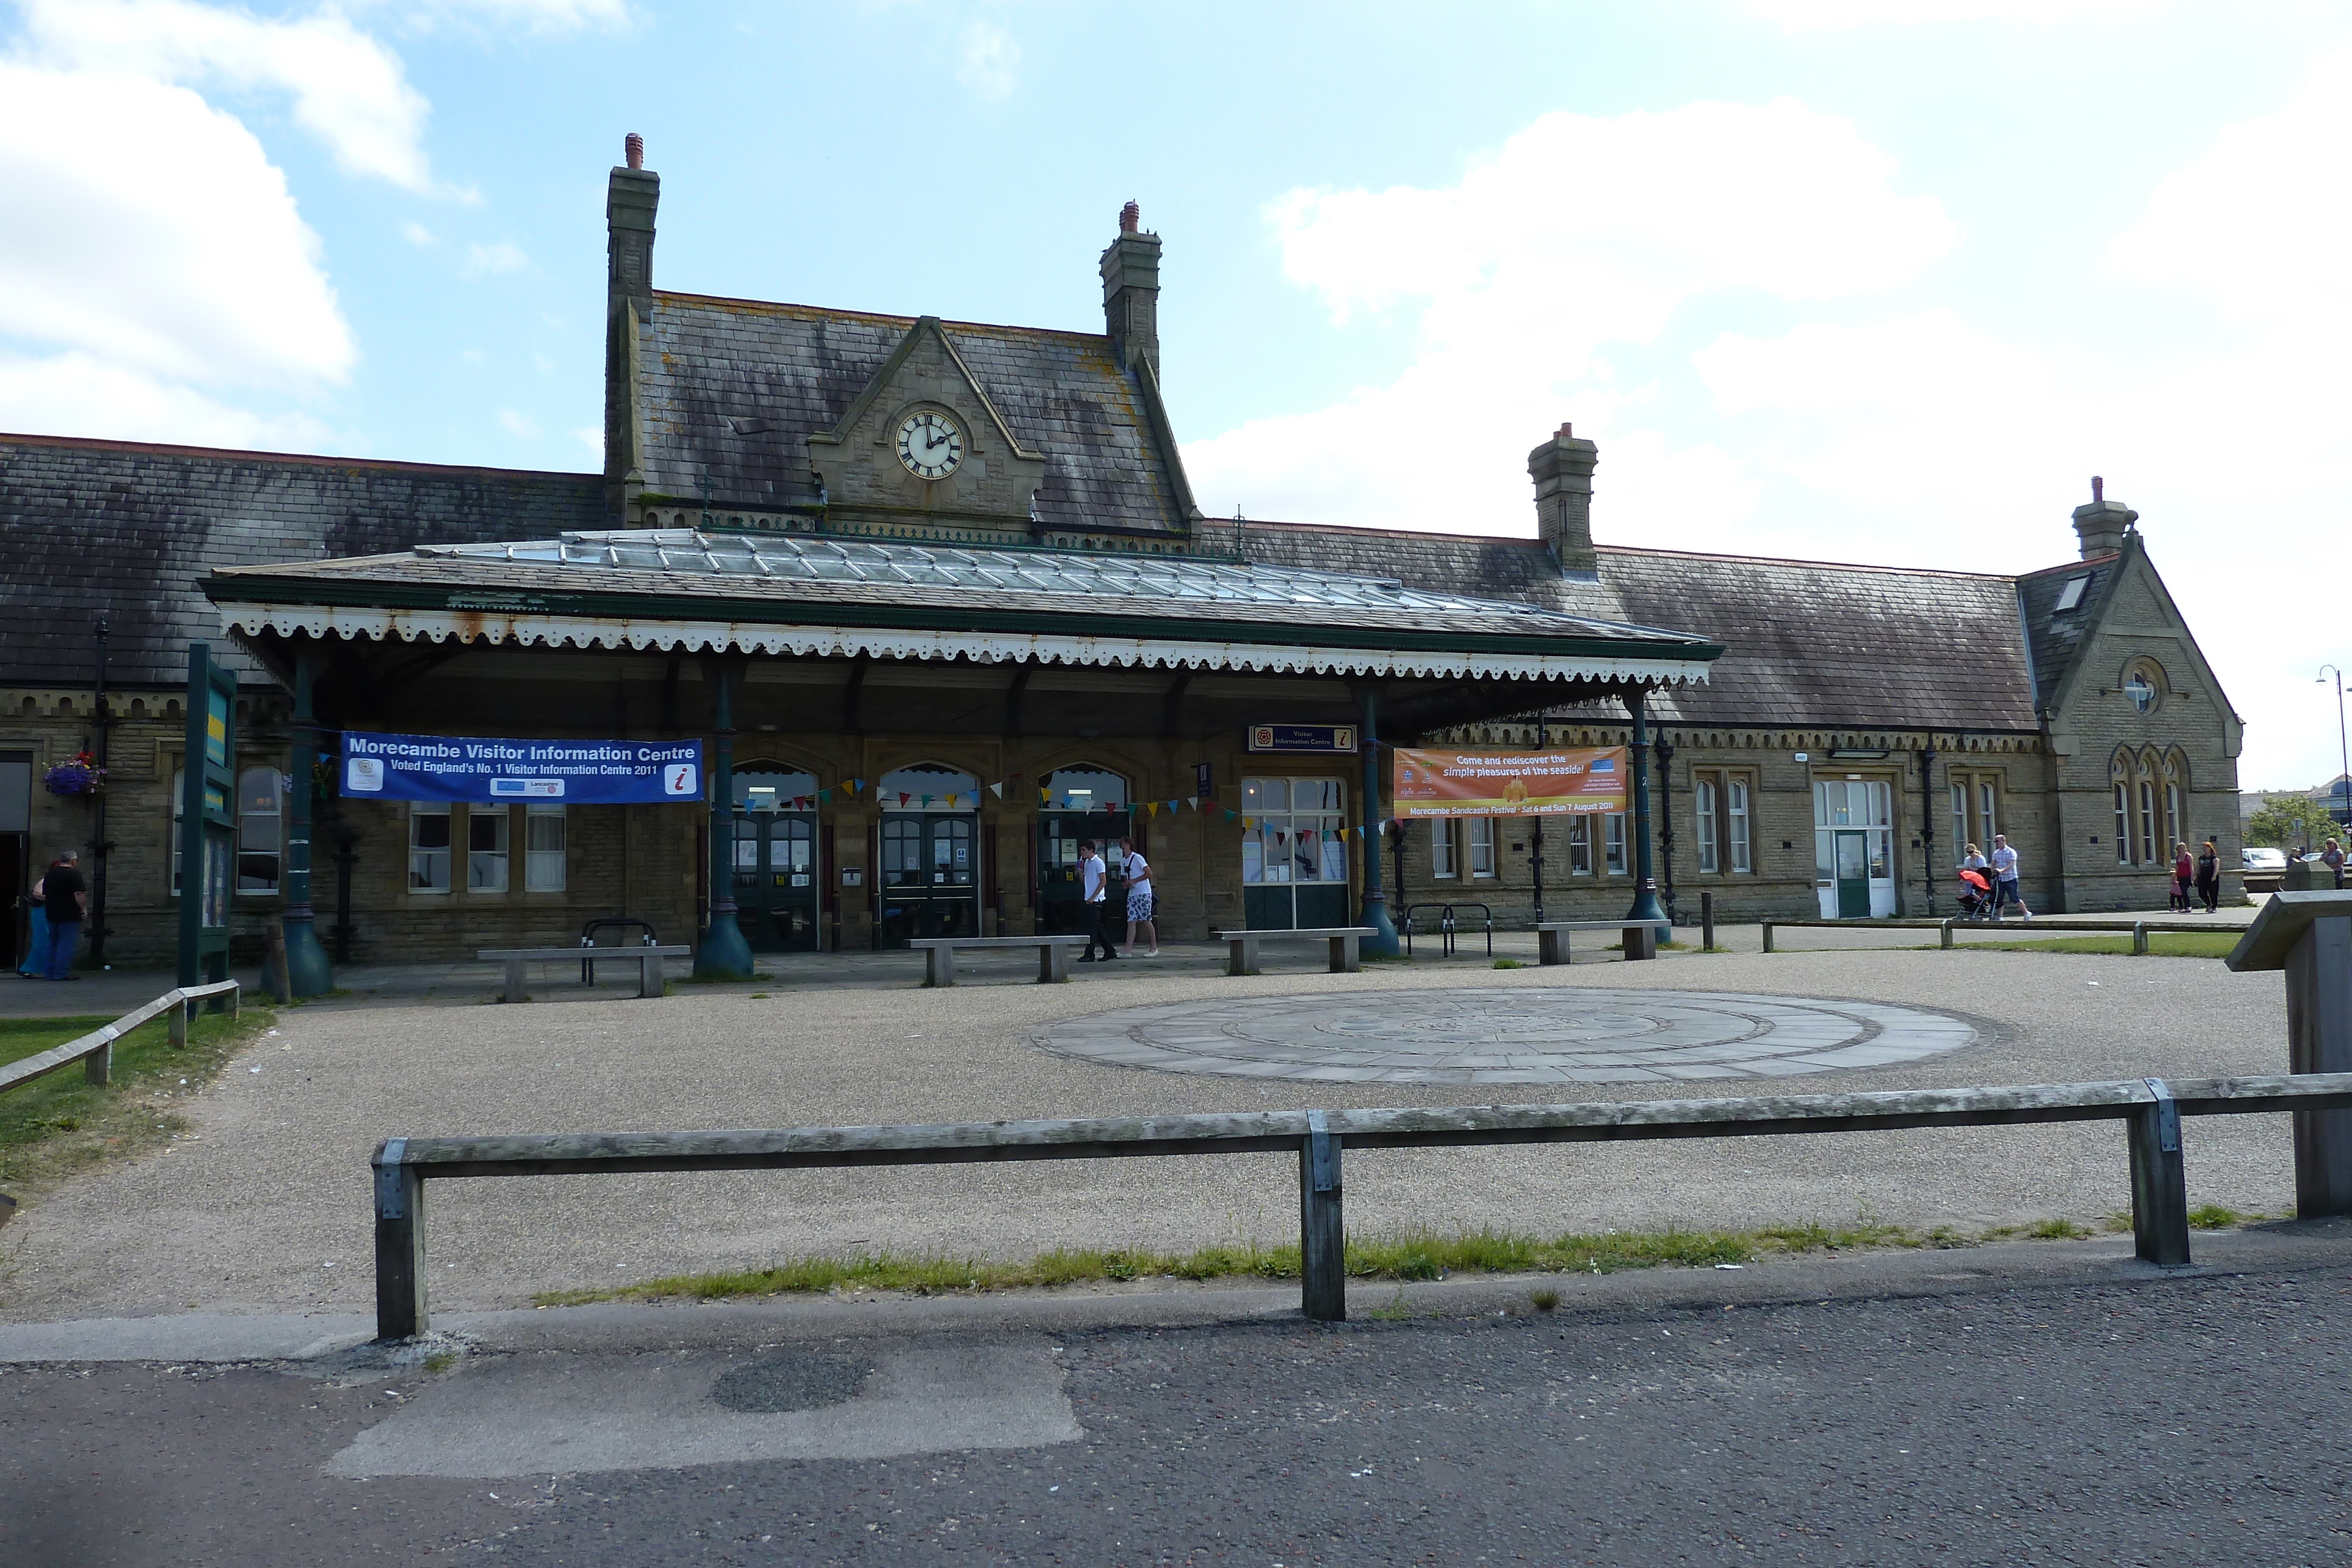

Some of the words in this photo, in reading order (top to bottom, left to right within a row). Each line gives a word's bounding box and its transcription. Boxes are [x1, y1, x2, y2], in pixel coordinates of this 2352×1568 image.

[349, 738, 460, 758] Morecambe
[466, 744, 524, 760] Visitor
[530, 747, 632, 760] Information
[638, 748, 695, 761] Centre
[1456, 755, 1482, 764] Come
[1485, 755, 1500, 765] and
[1502, 755, 1548, 764] rediscover
[1551, 754, 1566, 763] the
[391, 759, 420, 771] Voted
[423, 761, 474, 774] England's
[477, 764, 493, 774] No.
[496, 764, 501, 773] 1
[505, 764, 537, 774] Visitor
[540, 765, 597, 775] Information
[600, 765, 632, 775] Centre
[634, 765, 657, 775] 2011
[1444, 767, 1475, 778] simple
[1477, 767, 1520, 778] pleasures
[1522, 767, 1531, 775] of
[1533, 767, 1548, 775] the
[1551, 765, 1584, 775] seaside!
[1573, 803, 1598, 812] August
